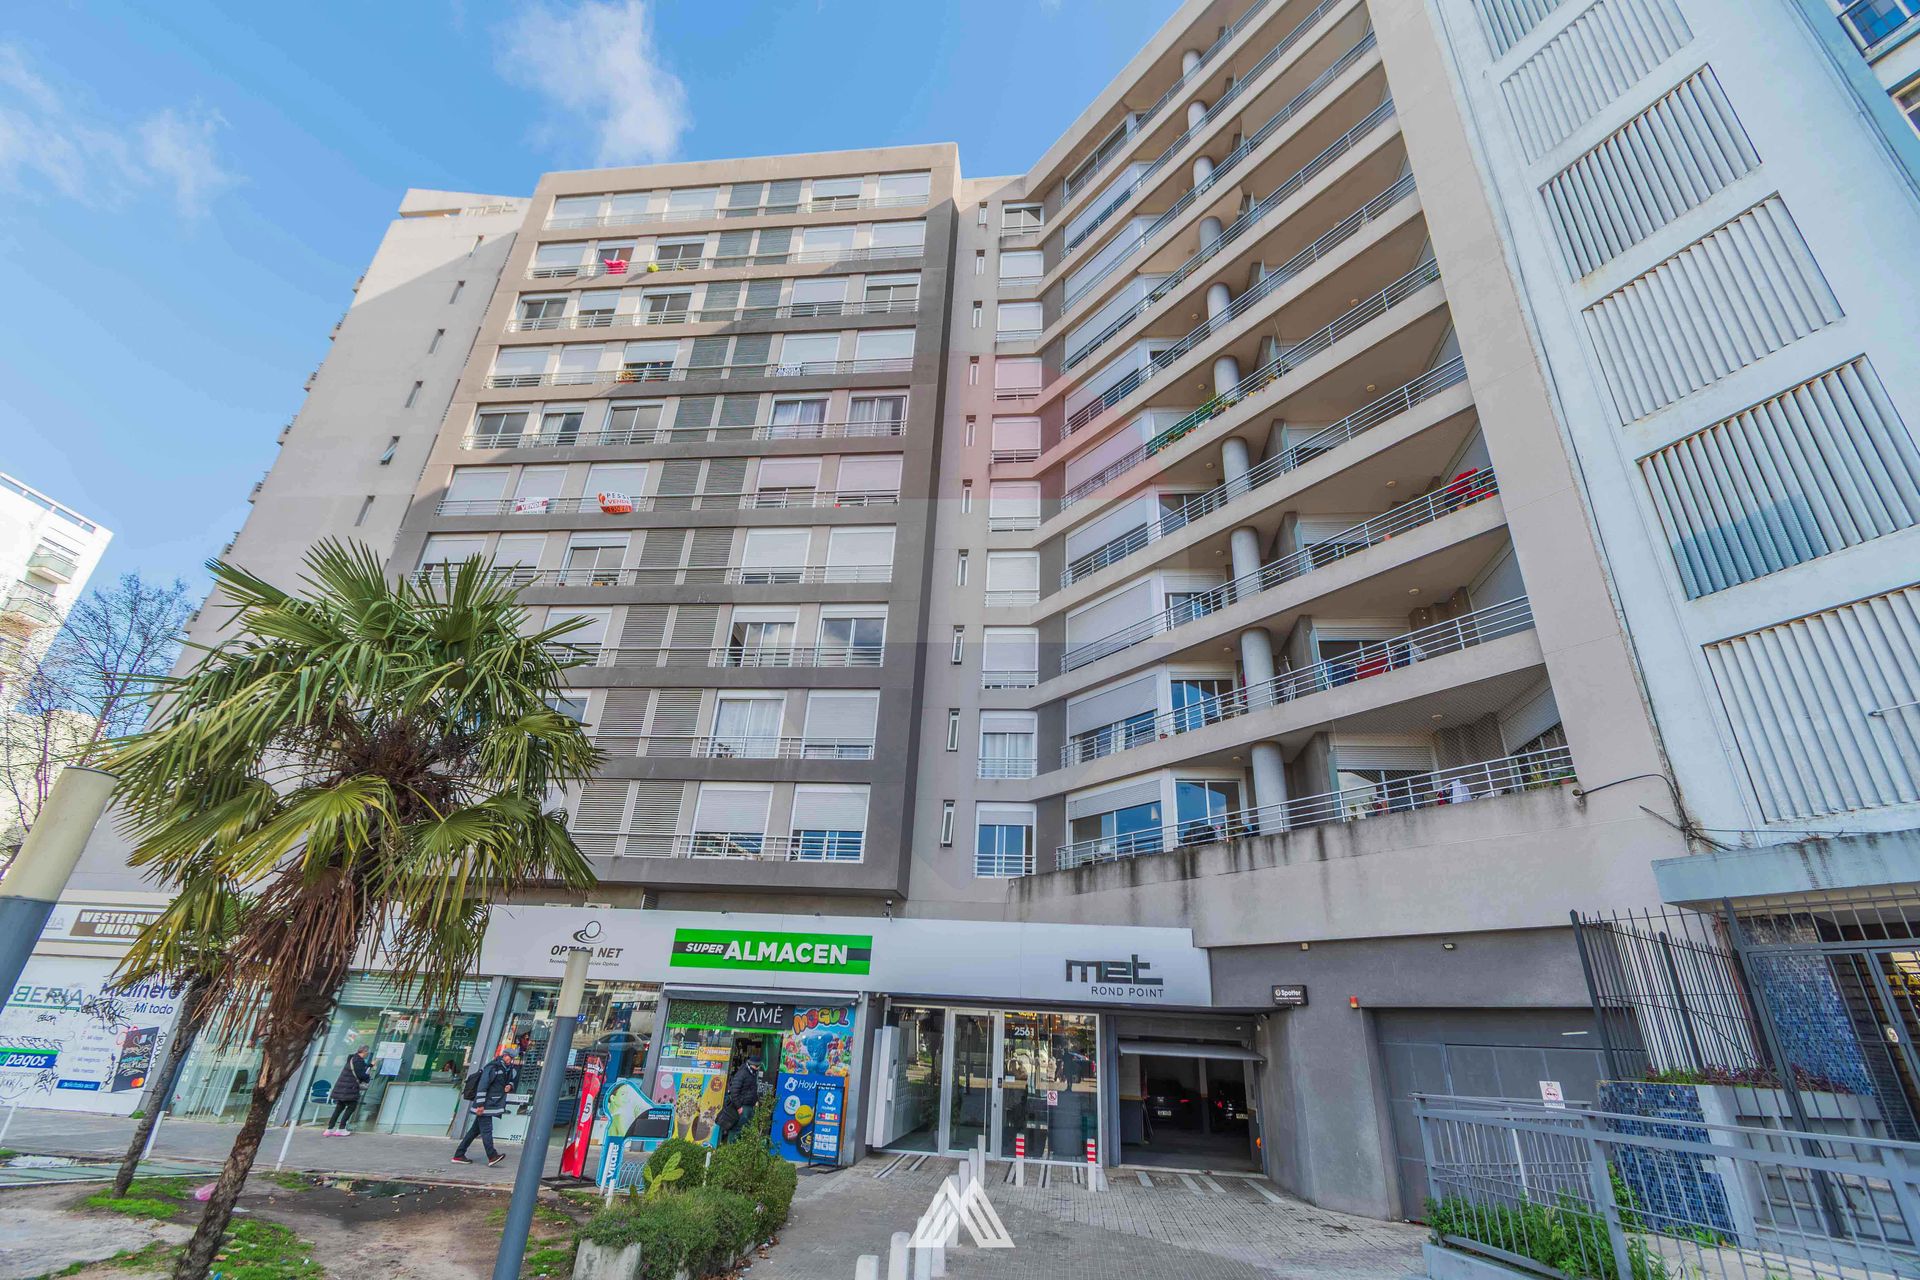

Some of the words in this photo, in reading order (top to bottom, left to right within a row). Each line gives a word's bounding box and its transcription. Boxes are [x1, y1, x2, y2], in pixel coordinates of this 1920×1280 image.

[80, 911, 146, 924] WESTERN
[94, 923, 141, 936] UNION
[597, 947, 624, 959] NET
[685, 942, 724, 954] SUPER
[723, 940, 848, 965] ALMACEN
[1091, 986, 1124, 996] ROND
[1128, 987, 1164, 998] POINT
[133, 1003, 149, 1014] Mi
[148, 1003, 174, 1015] todo
[793, 1008, 850, 1036] MOGUL
